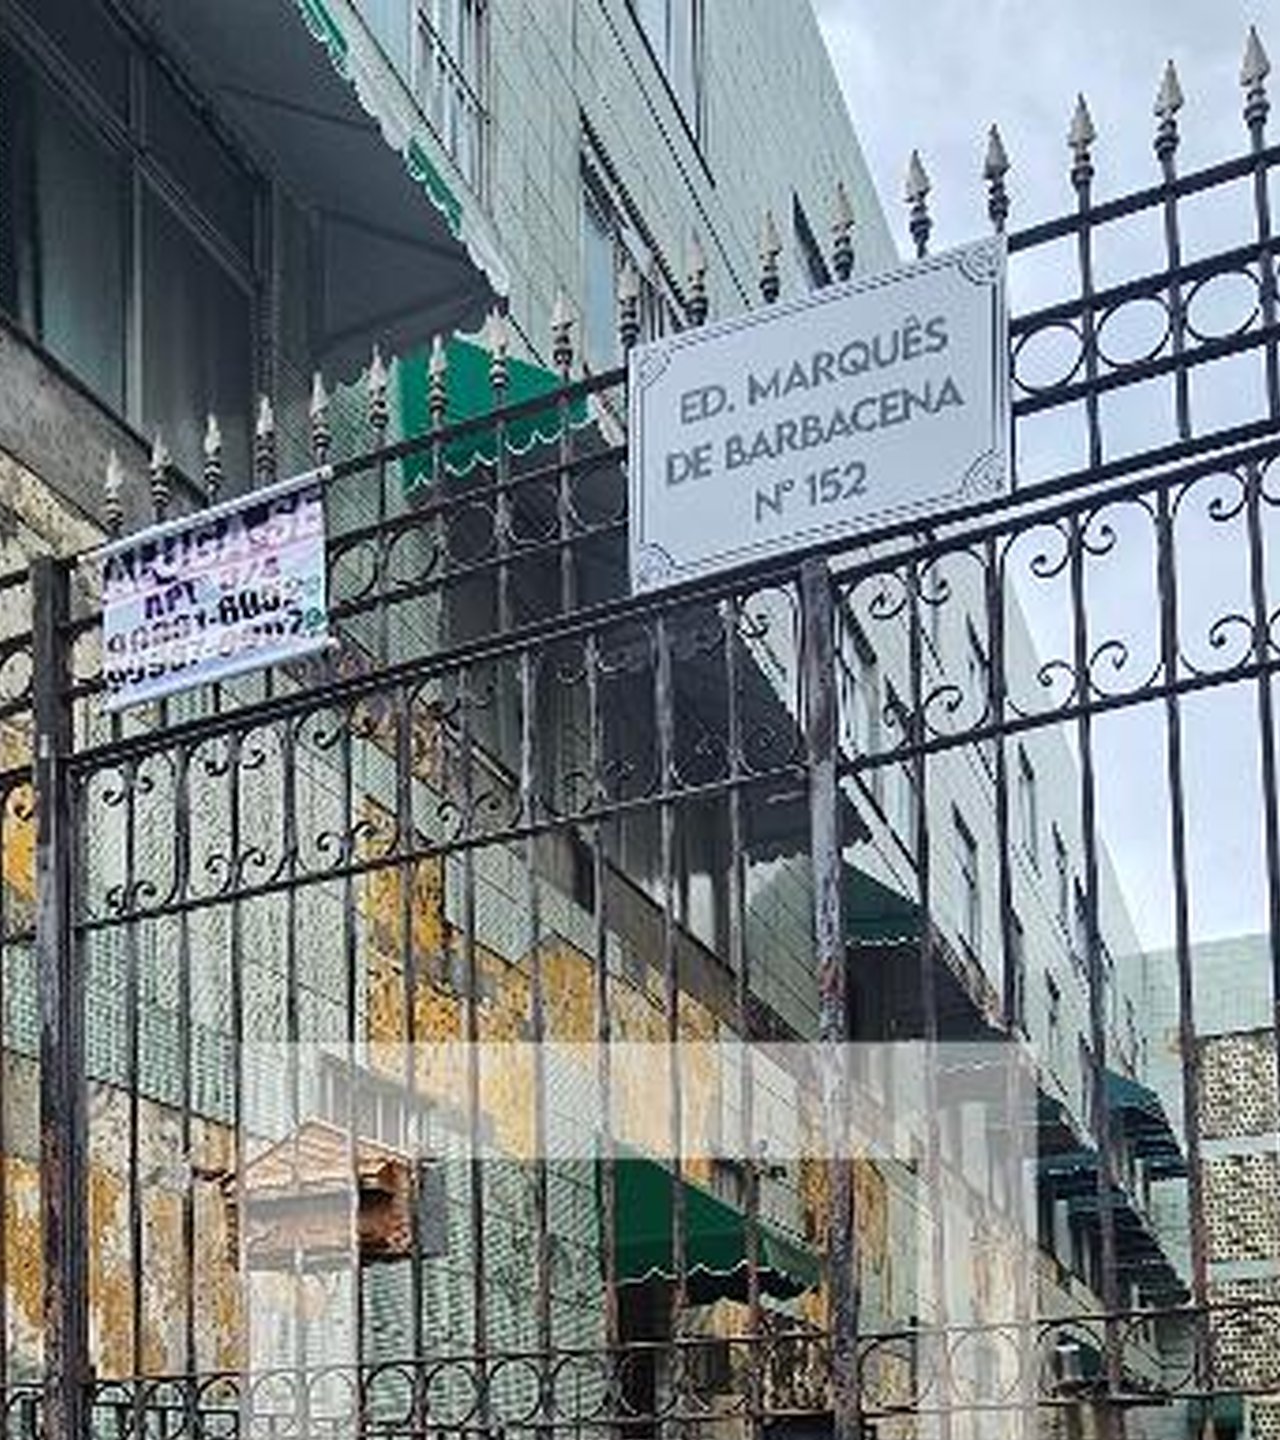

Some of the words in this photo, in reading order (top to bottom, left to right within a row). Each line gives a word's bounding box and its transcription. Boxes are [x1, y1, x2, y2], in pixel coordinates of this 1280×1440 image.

[679, 384, 736, 425] ED.
[747, 314, 949, 407] MARQUÊS
[665, 446, 715, 487] DE
[724, 376, 965, 470] BARBACENA
[806, 461, 868, 505] 152
